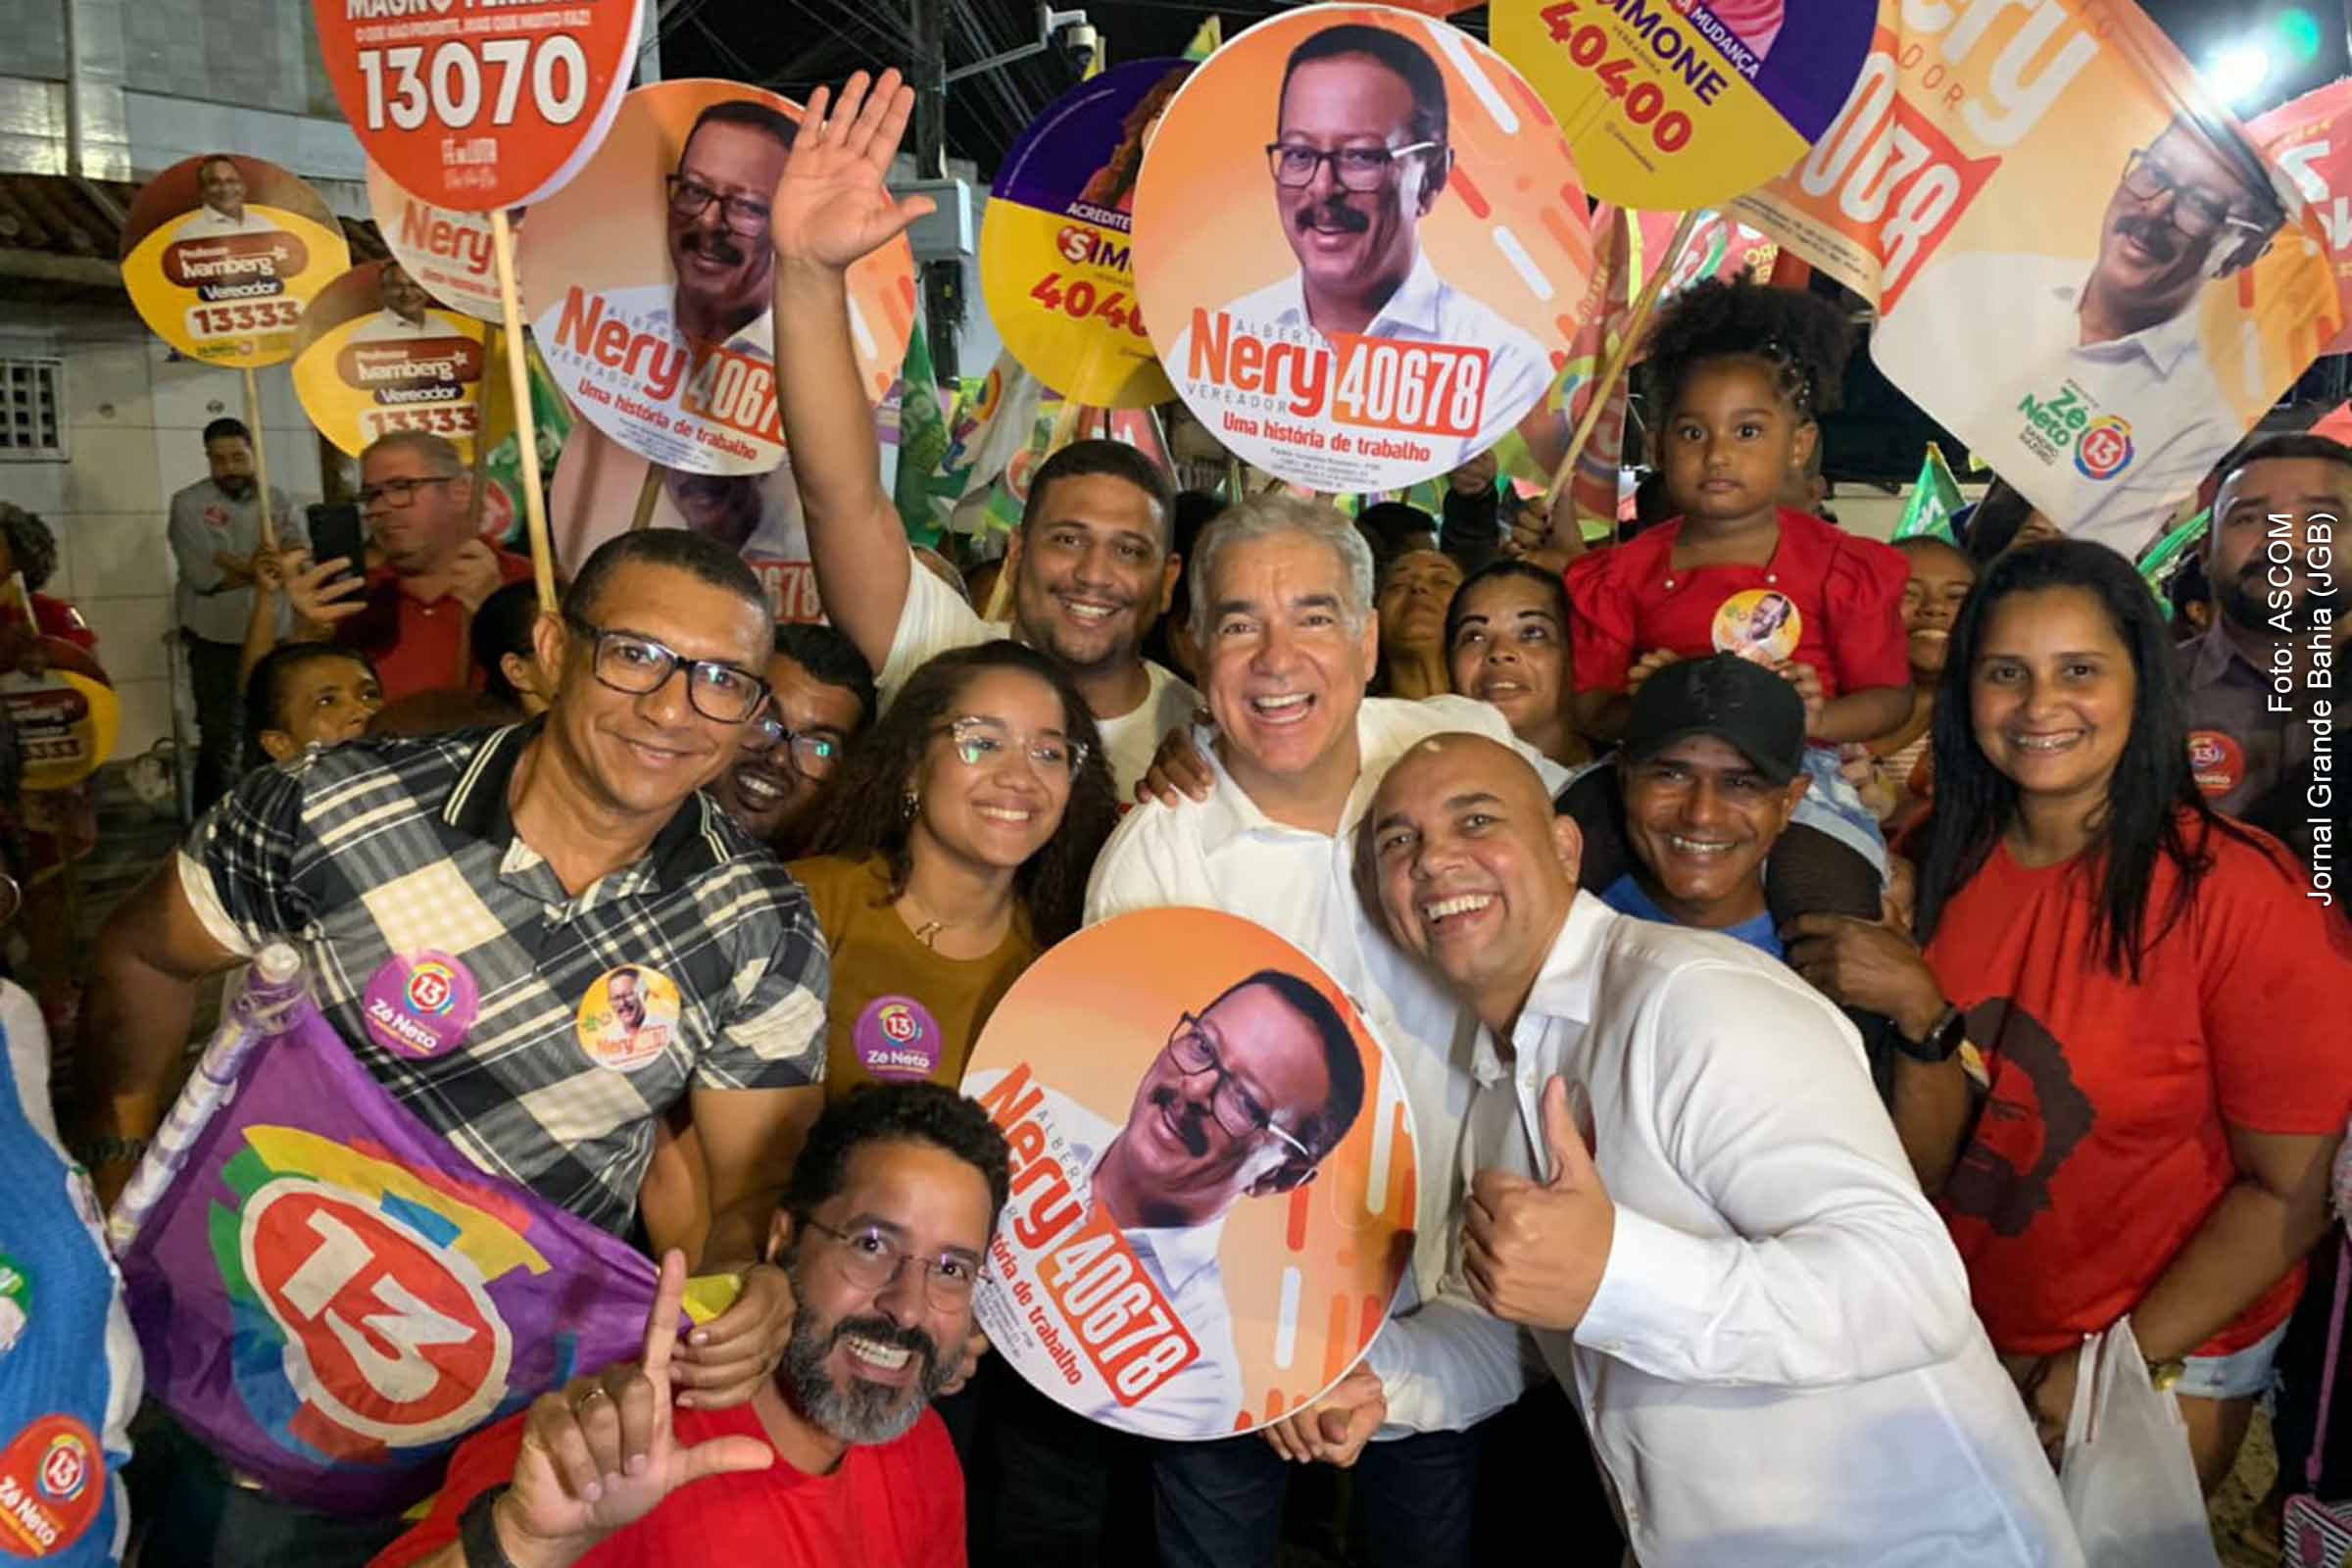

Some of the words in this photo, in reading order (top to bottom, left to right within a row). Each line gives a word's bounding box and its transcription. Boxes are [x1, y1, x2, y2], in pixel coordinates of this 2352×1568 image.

[1691, 10, 1760, 79] MUDANÇA
[359, 35, 587, 130] 13070
[1540, 3, 1692, 153] 40400
[401, 199, 494, 275] Nery
[1066, 201, 1133, 229] ACREDITE
[1064, 231, 1133, 273] SIM
[192, 301, 298, 334] 13333
[204, 280, 278, 300] Vereador
[554, 284, 686, 402] Nery
[1187, 306, 1330, 418] Nery
[1337, 344, 1483, 431] 40678
[1223, 411, 1259, 436] Uma
[1263, 419, 1325, 449] história
[1330, 432, 1352, 455] de
[1357, 439, 1432, 464] trabalho
[2017, 392, 2071, 447] Neto
[2086, 431, 2121, 466] 13
[414, 975, 445, 1004] 13
[391, 1013, 437, 1050] Neto
[888, 1016, 910, 1036] 13
[981, 1061, 1084, 1251] Nery
[279, 1207, 478, 1405] 13
[991, 1232, 1017, 1280] tória
[1013, 1280, 1034, 1307] de
[1028, 1306, 1084, 1387] trabalho
[1052, 1231, 1189, 1397] 40678
[48, 1450, 77, 1486] 13
[14, 1495, 57, 1547] Neto
